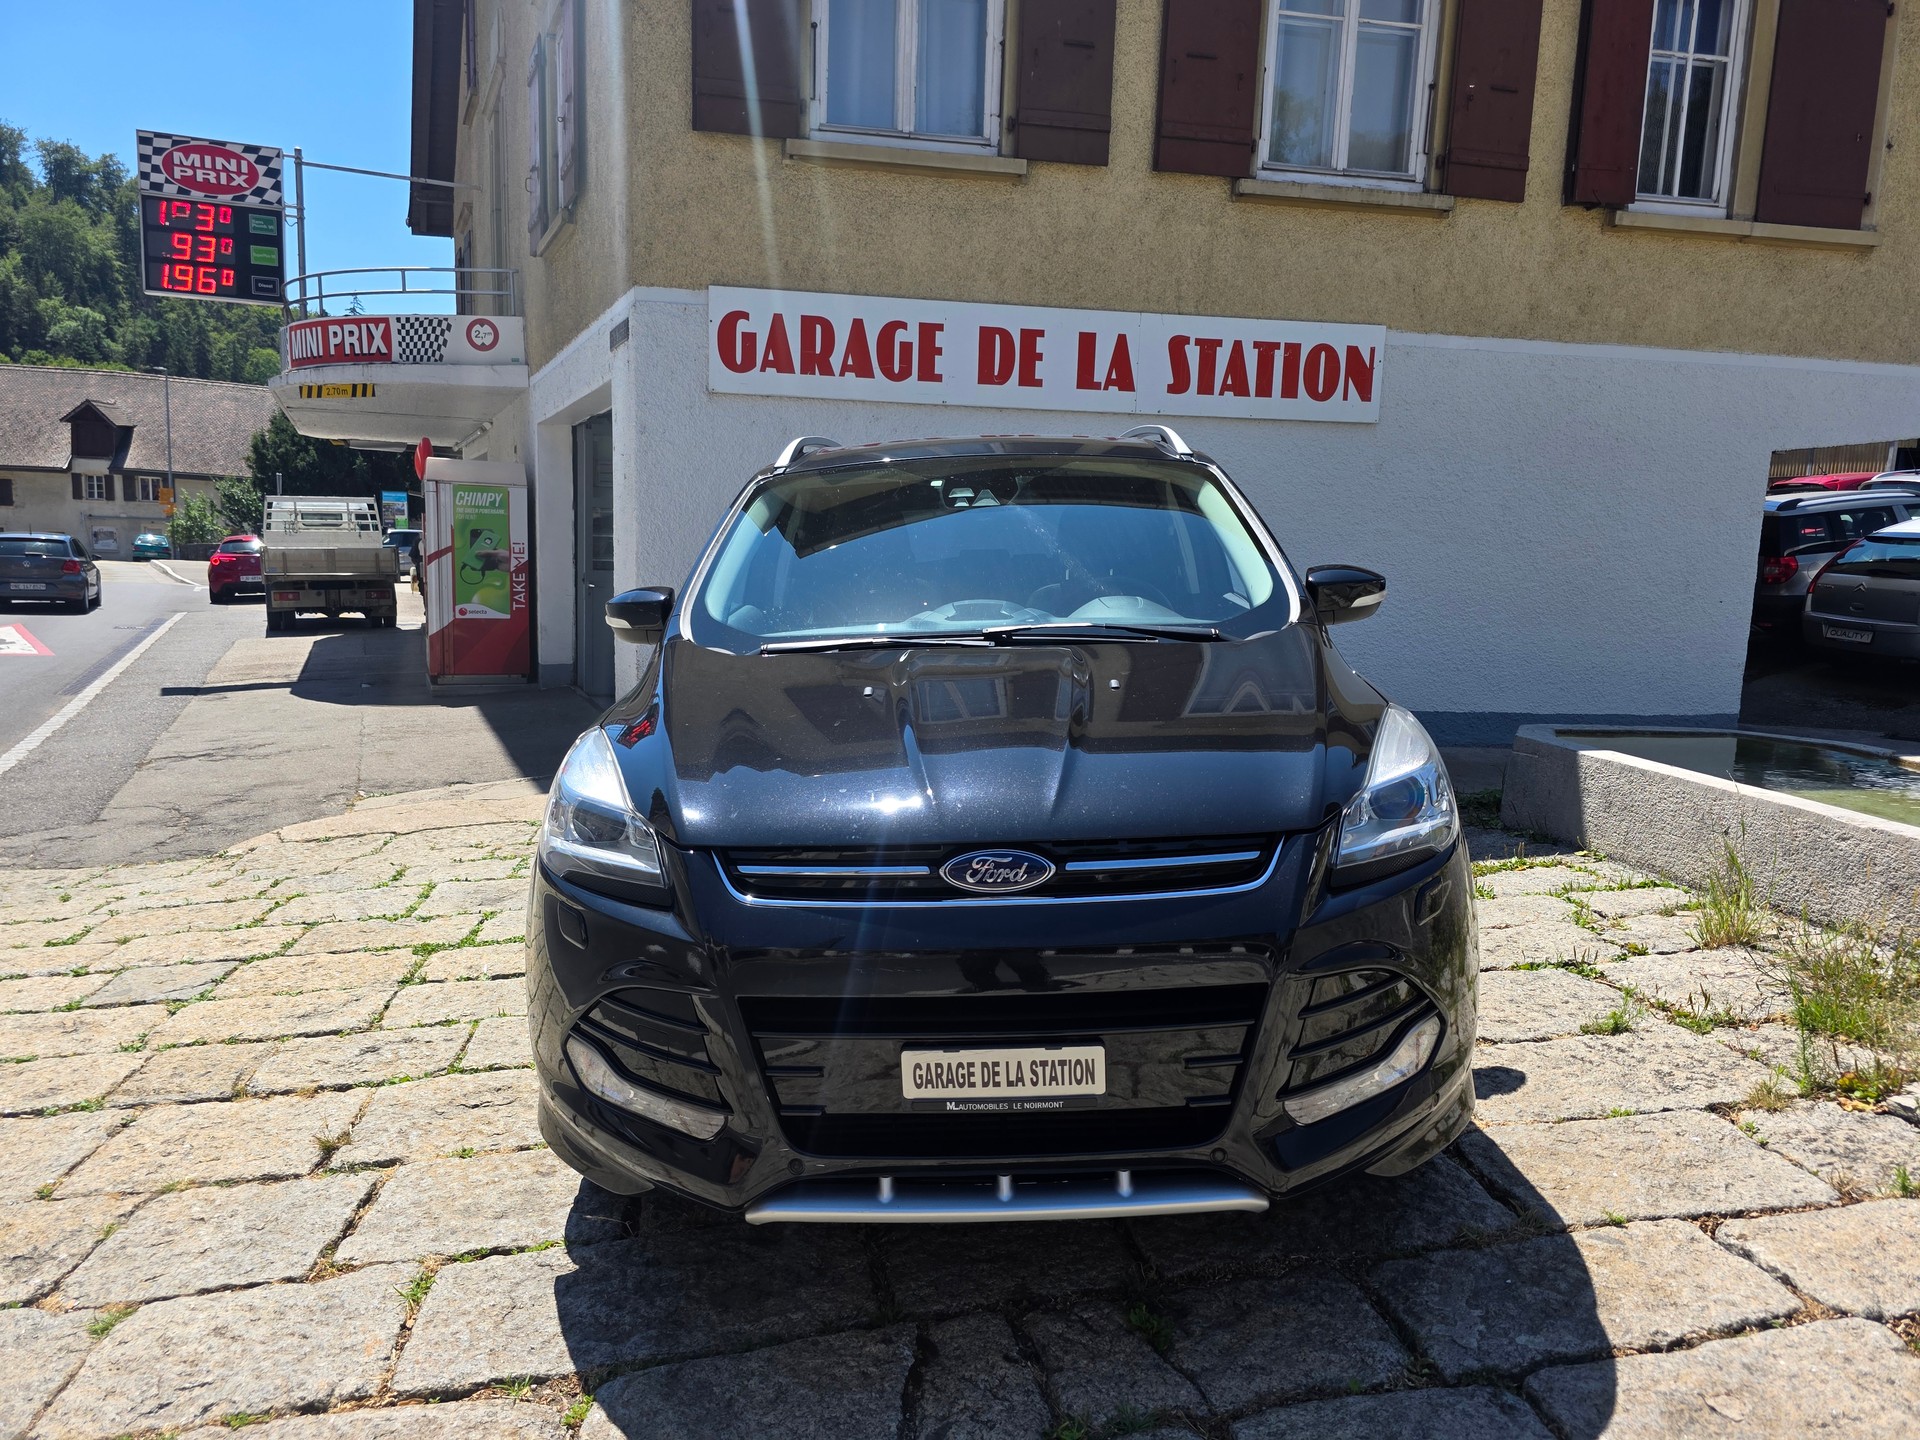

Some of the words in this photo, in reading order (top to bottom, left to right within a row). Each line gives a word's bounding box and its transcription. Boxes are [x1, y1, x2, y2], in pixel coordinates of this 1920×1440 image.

[172, 151, 249, 173] MINI
[173, 166, 250, 188] PRIX
[291, 326, 323, 360] MINI
[328, 323, 388, 355] PRIX
[716, 309, 944, 383] GARAGE
[977, 325, 1045, 388] DE
[1075, 331, 1136, 392] LA
[1165, 334, 1376, 403] STATION
[455, 491, 503, 507] CHIMPY
[512, 542, 525, 569] ME!
[512, 572, 526, 611] TAKE
[1830, 629, 1865, 640] QUALITY
[965, 856, 1028, 883] Ford
[912, 1061, 976, 1090] GARAGE
[981, 1061, 1000, 1089] DE
[1005, 1060, 1026, 1088] LA
[1029, 1058, 1096, 1087] STATION
[1013, 1101, 1022, 1110] LE
[1024, 1101, 1064, 1110] NOIRMONT
